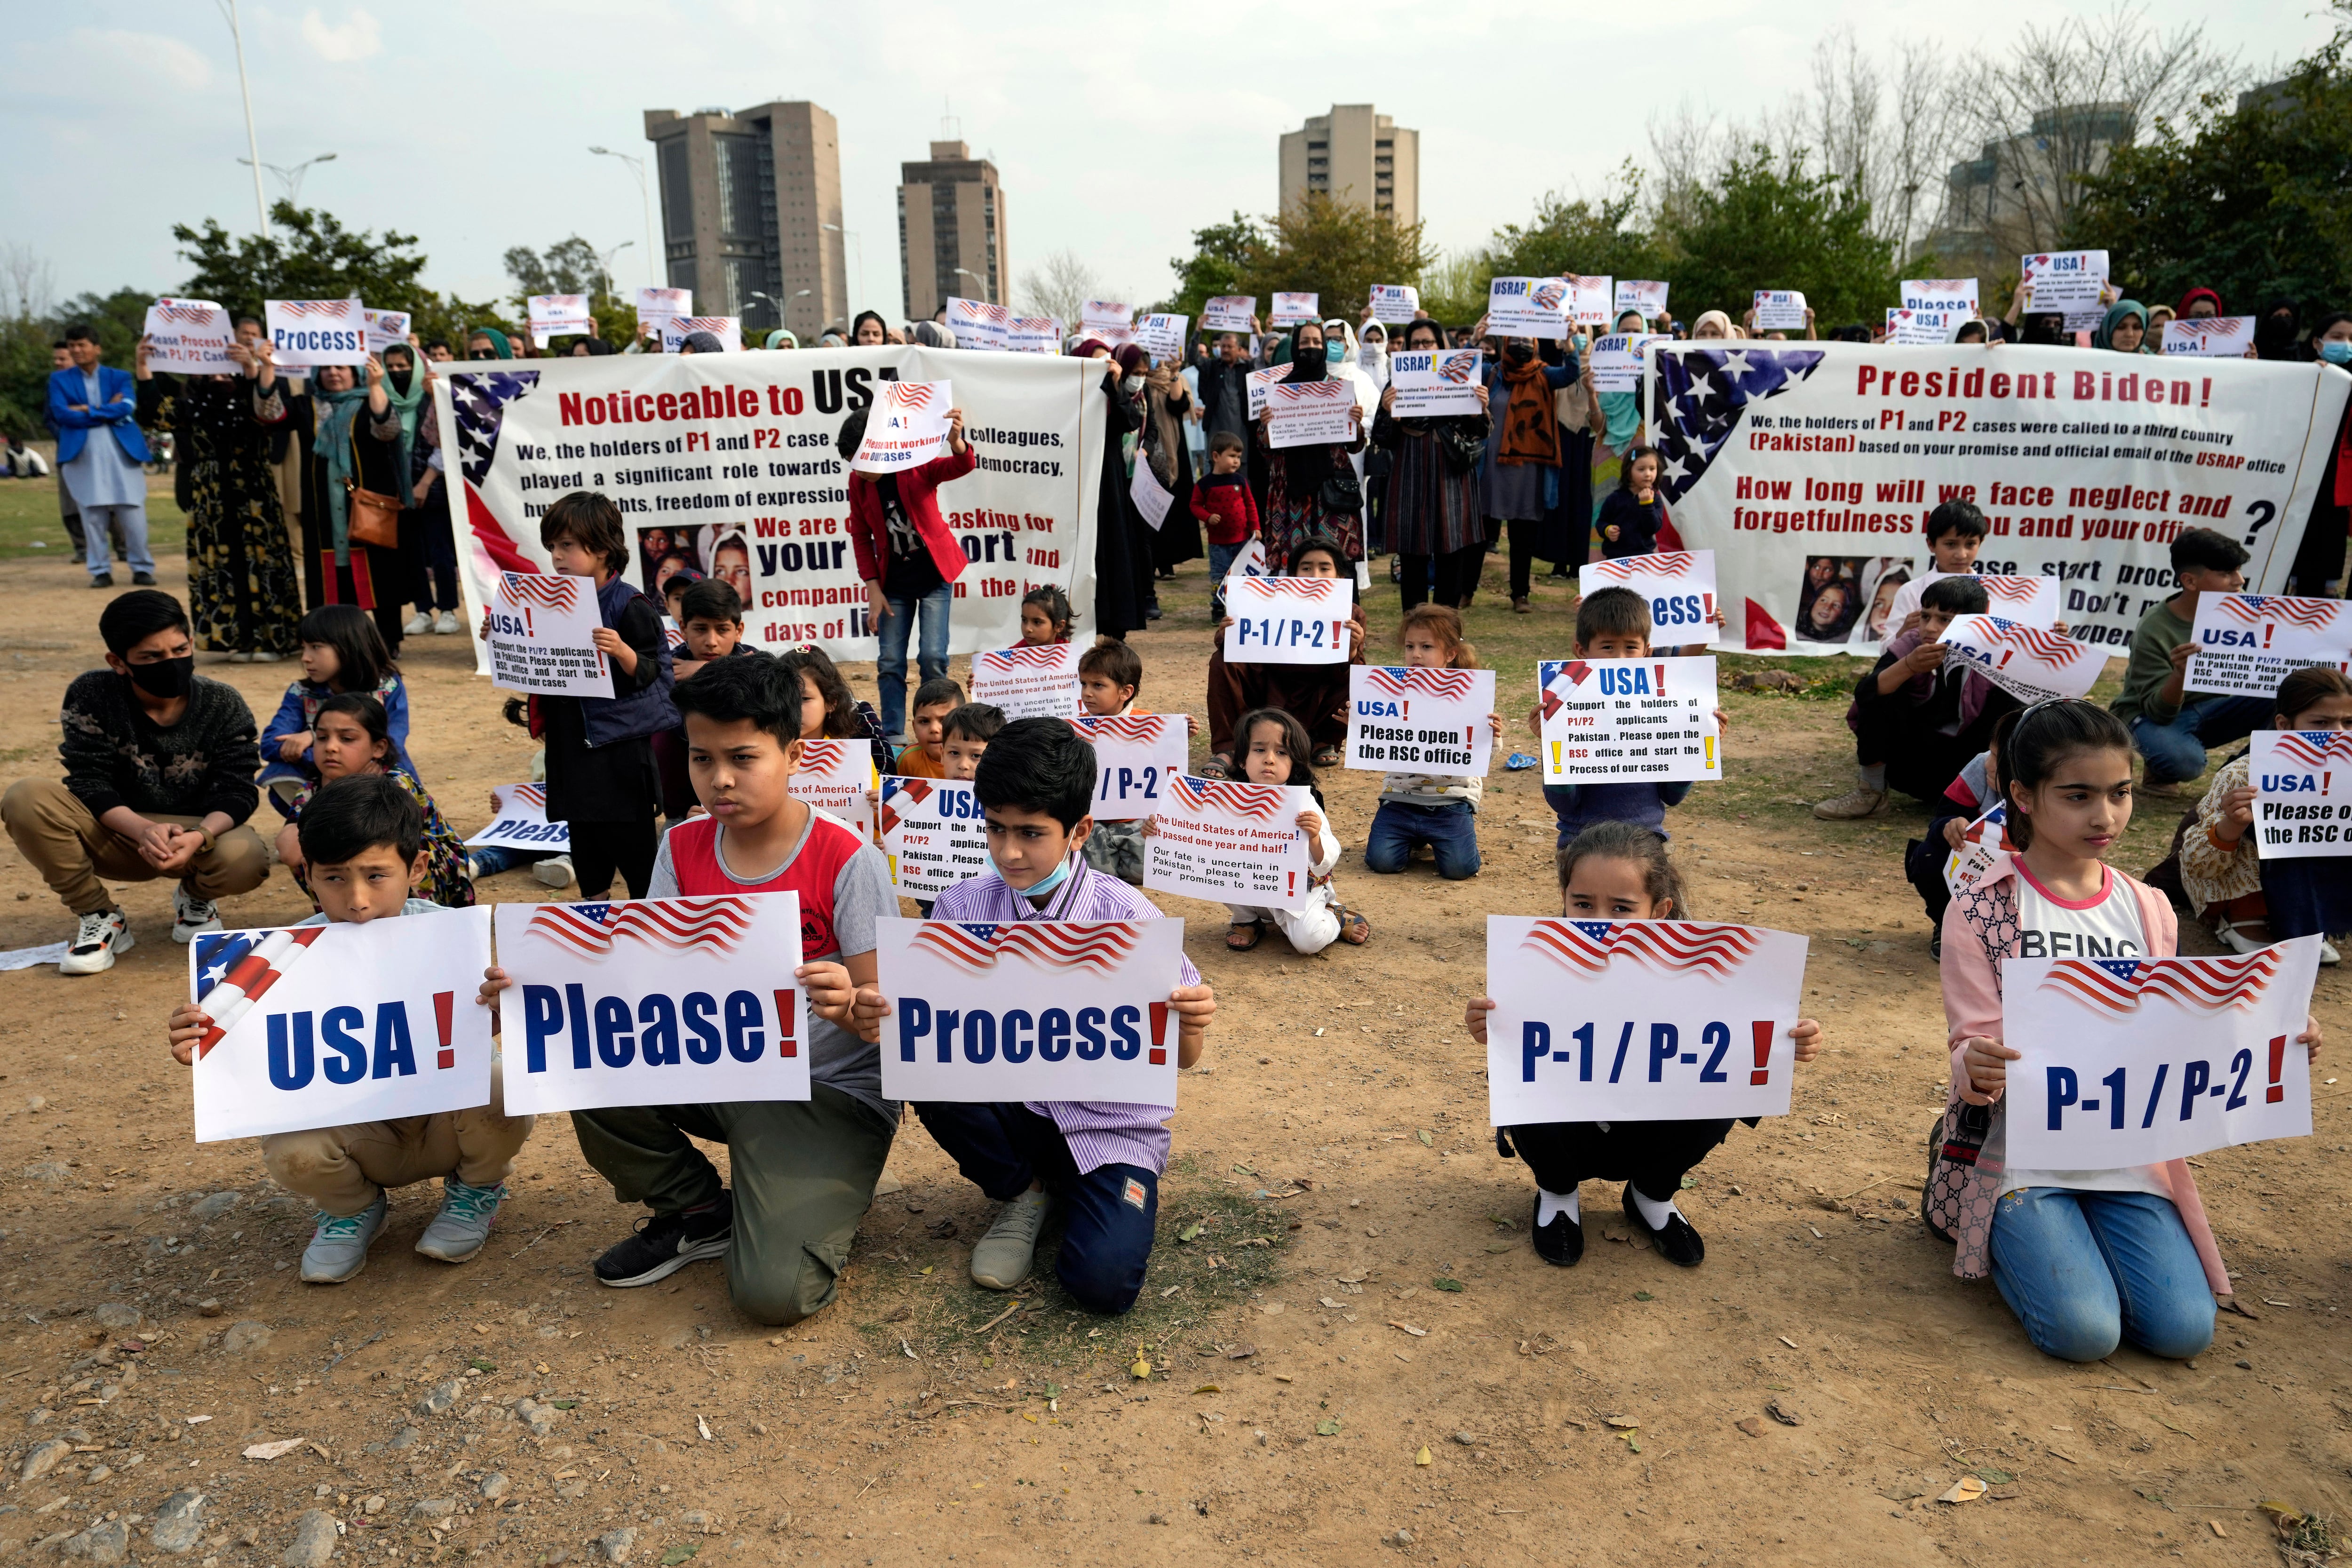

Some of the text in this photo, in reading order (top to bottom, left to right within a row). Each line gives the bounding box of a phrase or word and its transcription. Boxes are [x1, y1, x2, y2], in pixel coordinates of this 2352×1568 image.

[2054, 257, 2078, 270] USA
[1917, 314, 1939, 326] USA
[150, 334, 223, 347] lease Process
[275, 329, 365, 351] Process!
[2168, 342, 2198, 352] USA
[1396, 354, 1437, 372] USRAP!
[1858, 365, 2212, 408] President Biden!
[559, 385, 759, 426] Noticeable
[767, 385, 803, 416] to
[1751, 410, 2233, 446] We, the holders of P1 and P2 cases were called to a third country
[516, 427, 1064, 462] We, the holders of P1 and P2 case colleagues,
[900, 436, 940, 448] working
[1750, 433, 2286, 474] (Pakistan) based on your promise and official email of the USRAP office
[521, 471, 582, 491] played
[594, 473, 604, 486] a
[615, 464, 712, 486] significant
[723, 462, 758, 478] role
[768, 459, 842, 478] towards
[656, 492, 729, 511] freedom
[735, 491, 751, 507] of
[1736, 476, 2232, 518] How long will we face neglect and
[755, 509, 1053, 538] We are asking for
[1734, 507, 2140, 541] forgetfulness and your
[756, 539, 847, 577] your
[1027, 547, 1059, 569] and
[2042, 560, 2102, 581] start
[981, 578, 1016, 597] the
[2068, 589, 2130, 615] Don't
[491, 613, 524, 637] USA
[764, 619, 844, 642] days of
[1599, 667, 1650, 696] USA
[1358, 701, 1398, 717] USA
[1567, 701, 1605, 710] Support
[1568, 717, 1593, 725] P1/P2
[1617, 716, 1667, 725] applicants
[1360, 724, 1458, 744] Please open
[1656, 732, 1679, 740] open
[1359, 744, 1472, 764] the RSC office
[1596, 748, 1622, 757] office
[2262, 775, 2316, 792] USA
[2263, 803, 2333, 820] Please
[481, 820, 569, 842] Pleas
[1156, 813, 1169, 824] The
[1171, 818, 1200, 831] United
[1203, 824, 1235, 836] States
[1238, 828, 1248, 837] of
[2265, 825, 2338, 844] the RSC
[522, 982, 798, 1074] Please!
[898, 997, 1168, 1066] Process!
[266, 1001, 417, 1091] USA
